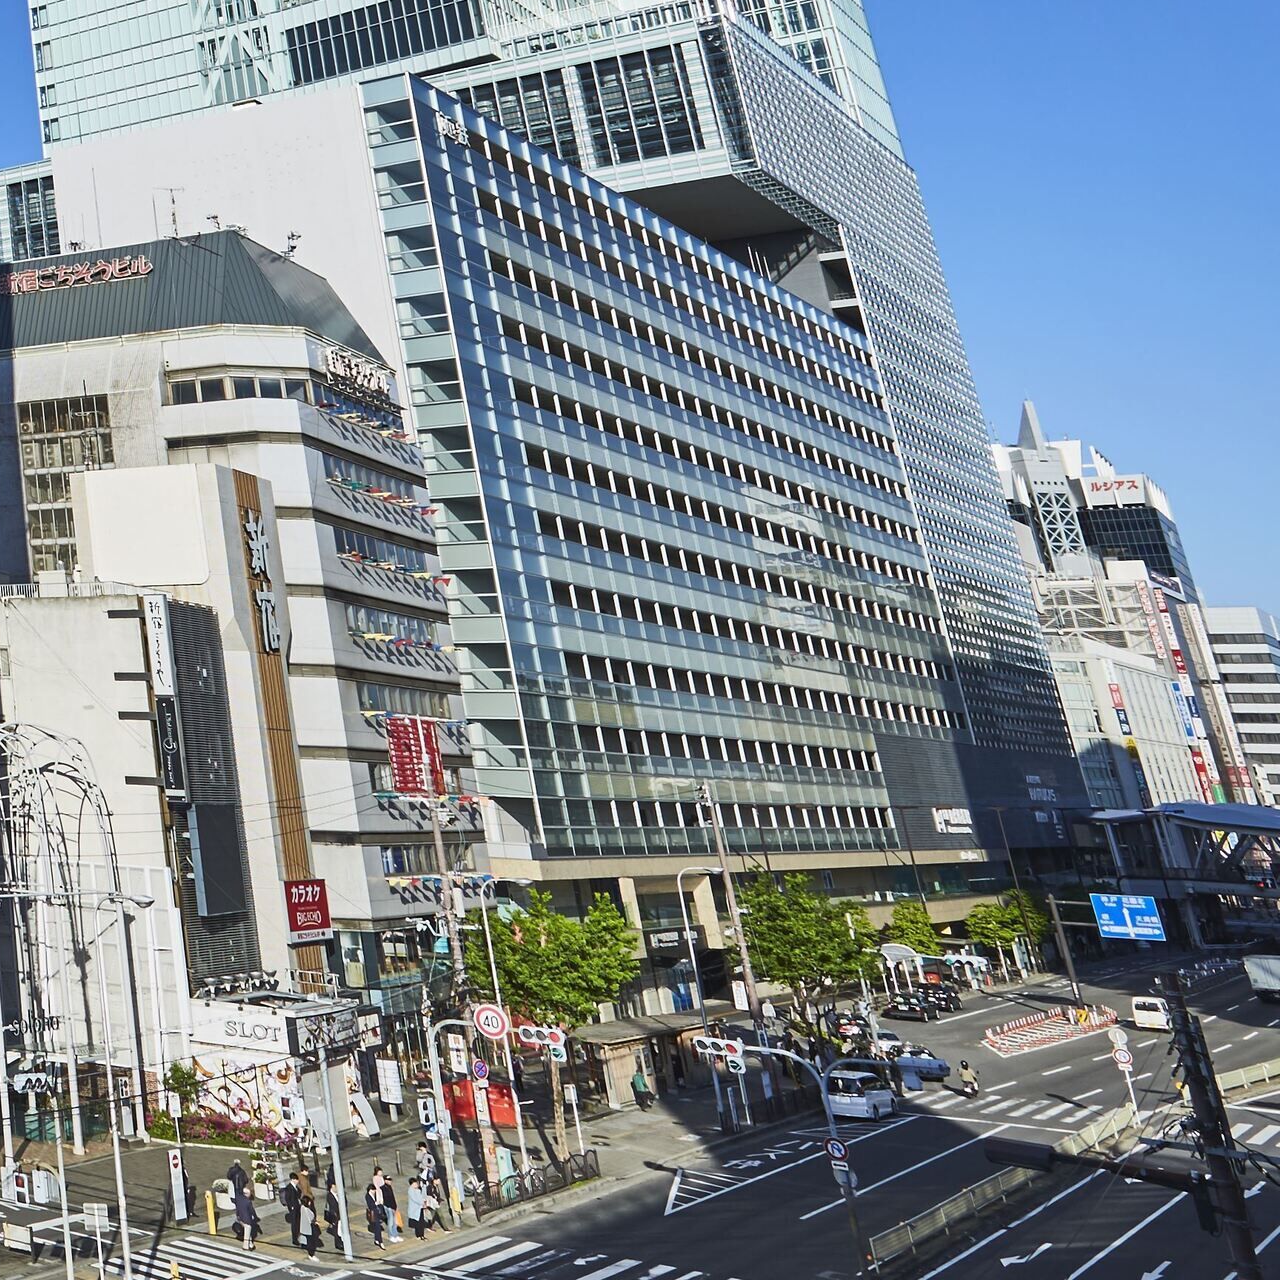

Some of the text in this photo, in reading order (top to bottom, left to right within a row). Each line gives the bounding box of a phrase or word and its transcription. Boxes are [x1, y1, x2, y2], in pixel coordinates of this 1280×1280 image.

[1091, 480, 1138, 492] ルシアス
[246, 508, 281, 652] 新宿
[290, 885, 321, 903] カラオケ
[483, 1015, 499, 1029] 40
[224, 1020, 281, 1043] SLOT
